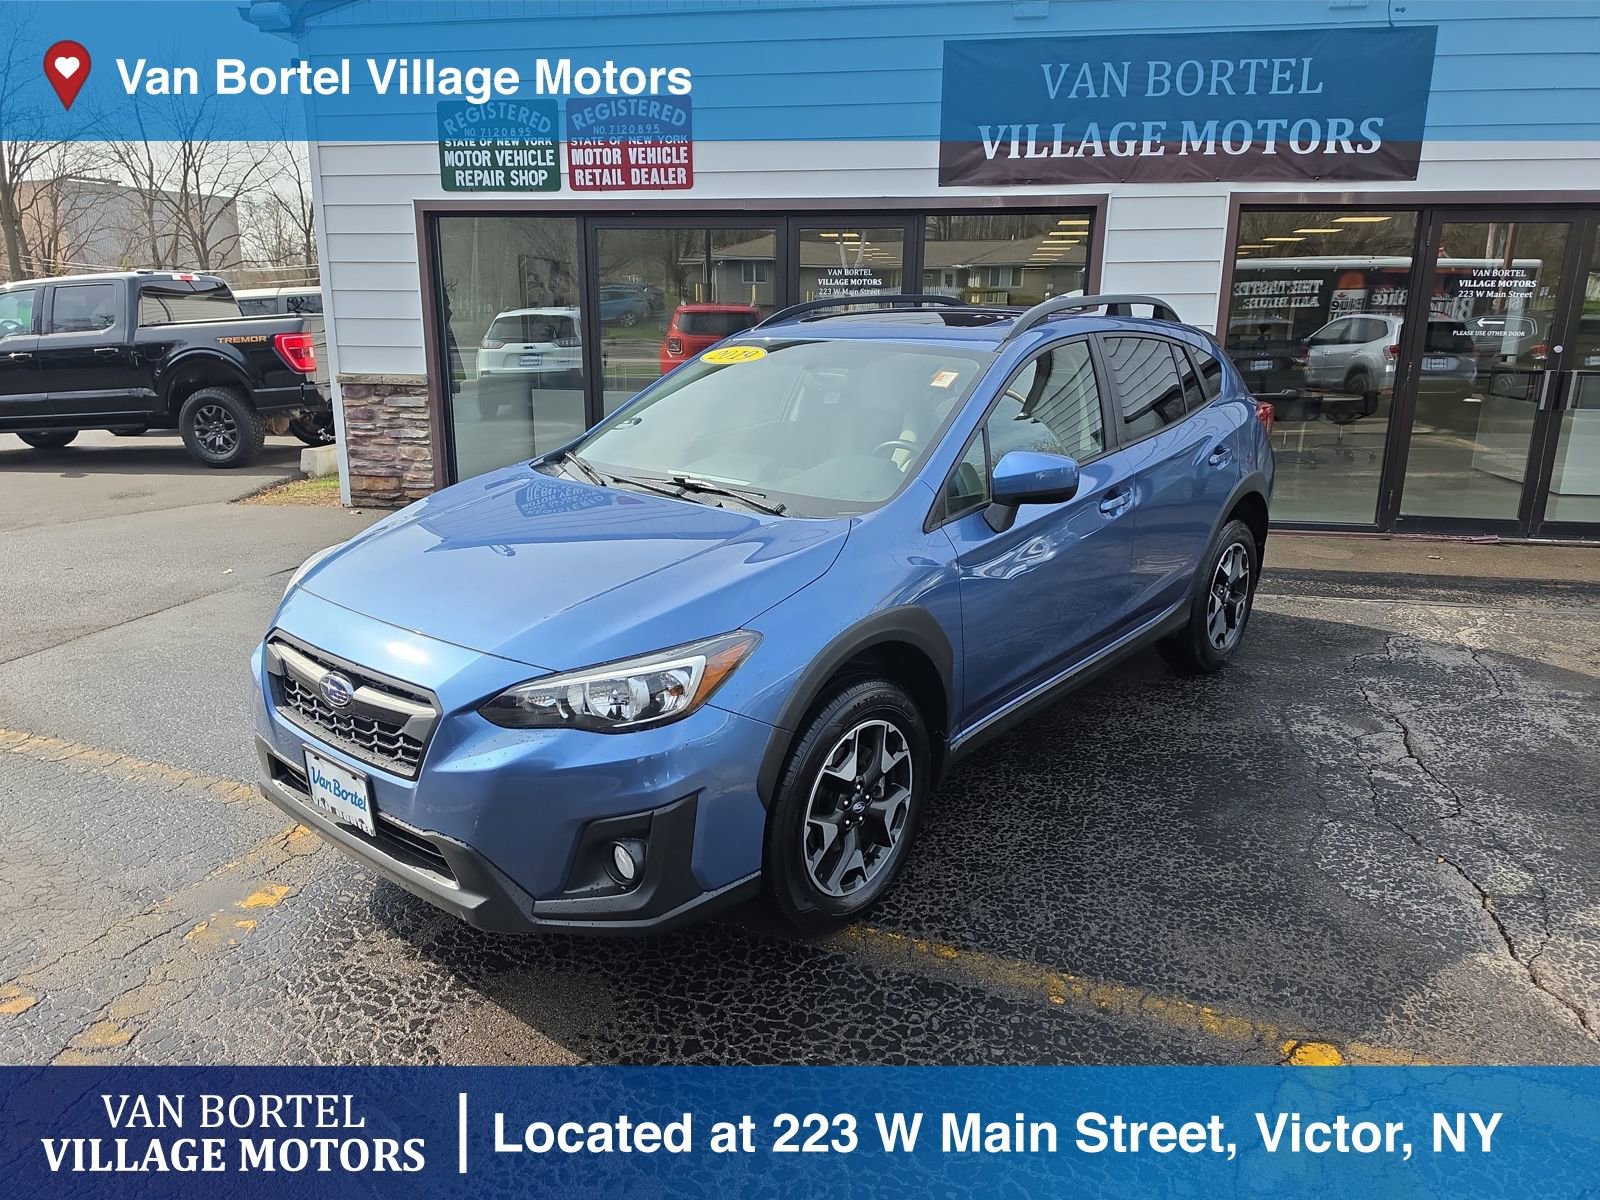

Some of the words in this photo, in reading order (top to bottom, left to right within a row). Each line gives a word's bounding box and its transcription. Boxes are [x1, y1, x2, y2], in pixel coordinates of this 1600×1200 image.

[1041, 61, 1131, 100] VAN
[1144, 57, 1324, 97] BORTEL
[443, 102, 551, 135] REGISTERED
[571, 98, 687, 131] REGISTERED
[480, 127, 531, 137] 7120895
[609, 124, 660, 134] 7120895
[445, 138, 476, 147] STATE
[479, 138, 491, 146] OF
[497, 137, 520, 146] NEW
[522, 137, 552, 146] YORK
[571, 136, 604, 146] STATE
[609, 136, 624, 145] OF
[628, 135, 651, 145] NEW
[657, 134, 688, 144] YORK
[978, 120, 1167, 160] VILLAGE
[1178, 117, 1384, 156] MOTORS
[444, 150, 491, 167] MOTOR
[495, 149, 555, 166] VEHICLE
[571, 148, 621, 165] MOTOR
[628, 146, 688, 164] VEHICLE
[455, 170, 505, 186] REPAIR
[510, 170, 548, 186] SHOP
[574, 168, 625, 186] RETAIL
[631, 167, 687, 185] DEALER
[827, 268, 842, 276] VAN
[844, 268, 872, 276] BORTEL
[1472, 269, 1490, 277] VAN
[1492, 269, 1526, 277] BORTEL
[818, 278, 848, 286] VILLAGE
[850, 278, 882, 286] MOTORS
[1459, 279, 1496, 288] VILLAGE
[1497, 280, 1537, 288] MOTORS
[860, 287, 881, 295] Street
[1458, 290, 1474, 298] 223
[1475, 290, 1485, 298] W
[1486, 290, 1506, 298] Main
[1508, 290, 1533, 298] Street
[217, 335, 267, 344] TREMOR
